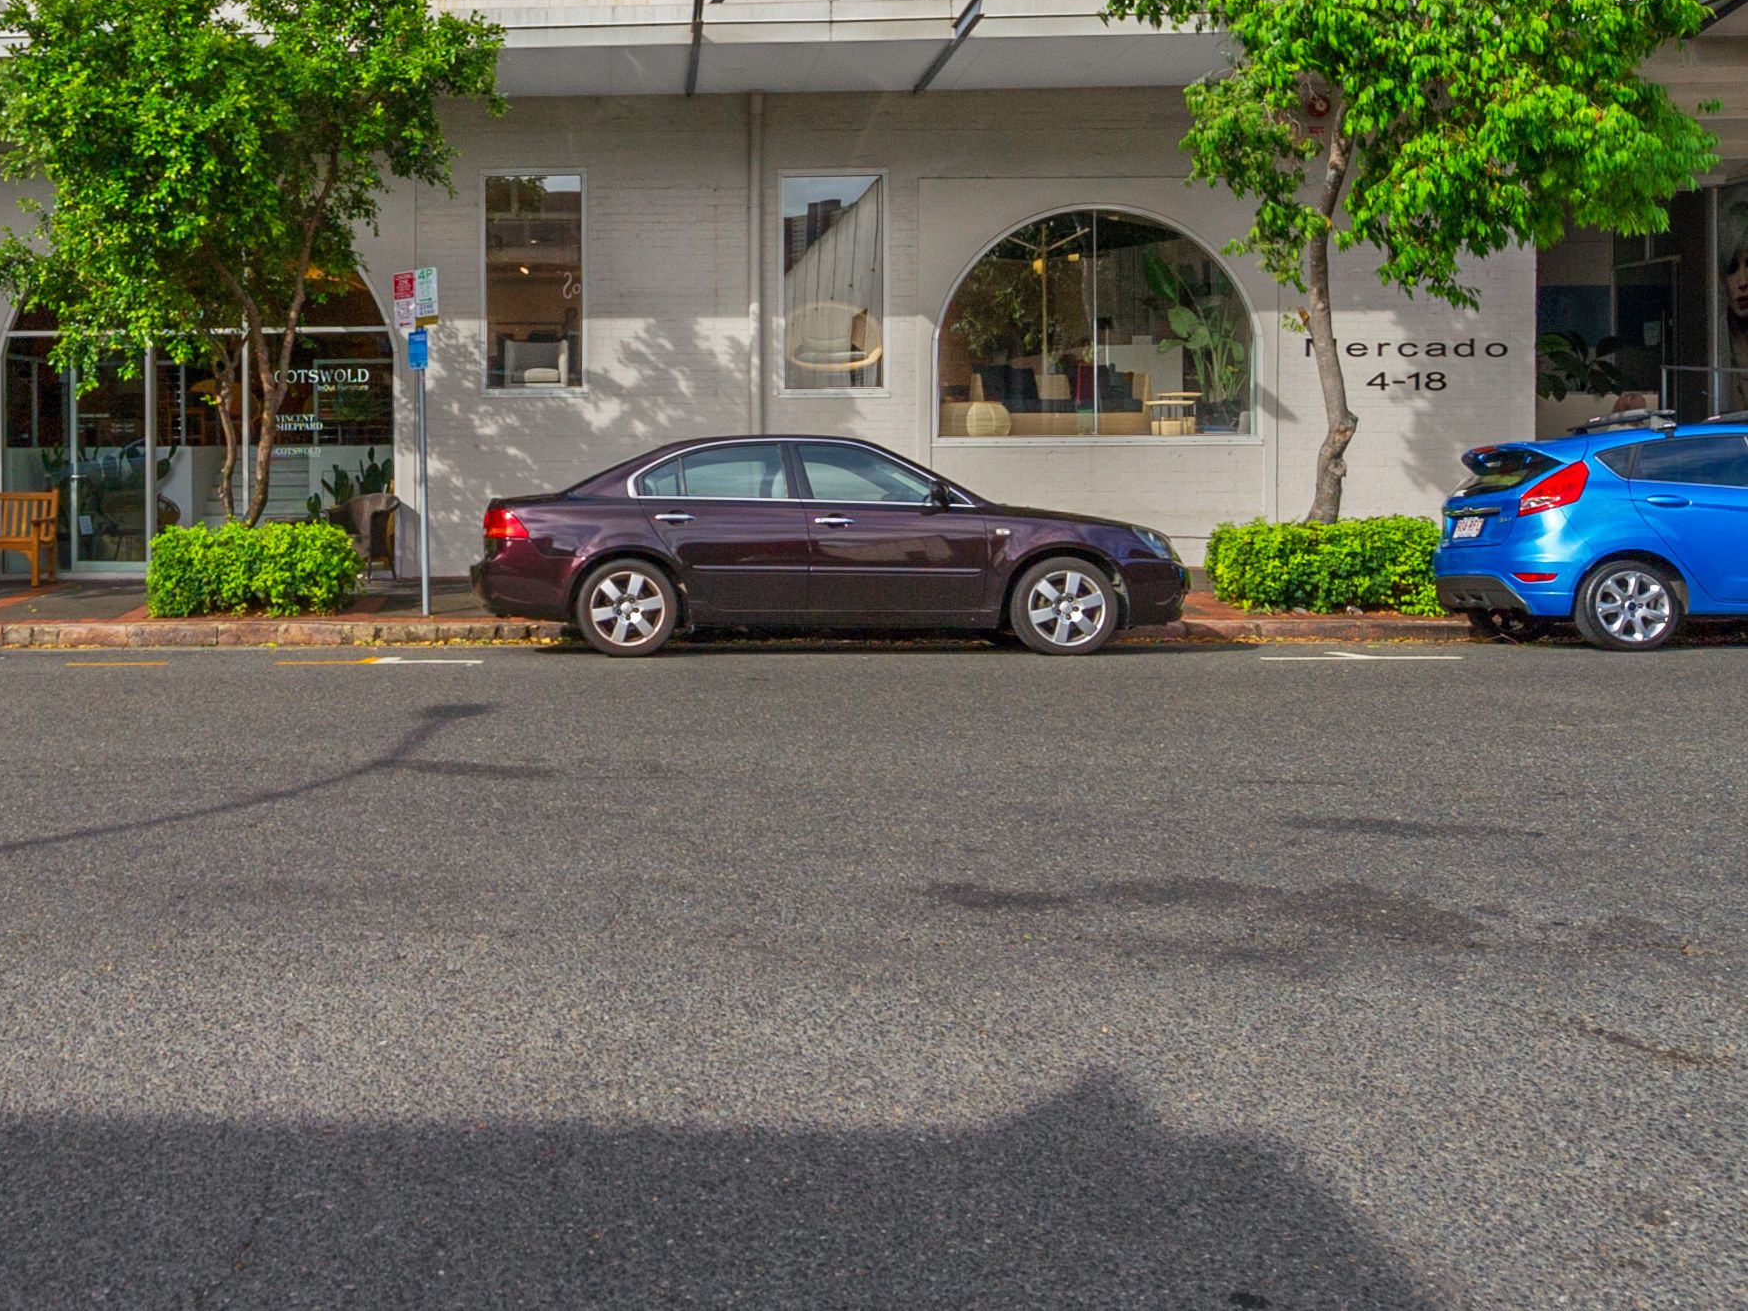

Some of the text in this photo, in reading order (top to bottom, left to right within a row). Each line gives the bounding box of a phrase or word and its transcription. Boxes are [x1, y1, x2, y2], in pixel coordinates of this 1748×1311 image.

[418, 269, 433, 280] 4P
[1366, 372, 1448, 391] 4-18
[275, 414, 316, 422] VINCENT
[275, 422, 324, 431] SHEPPARD
